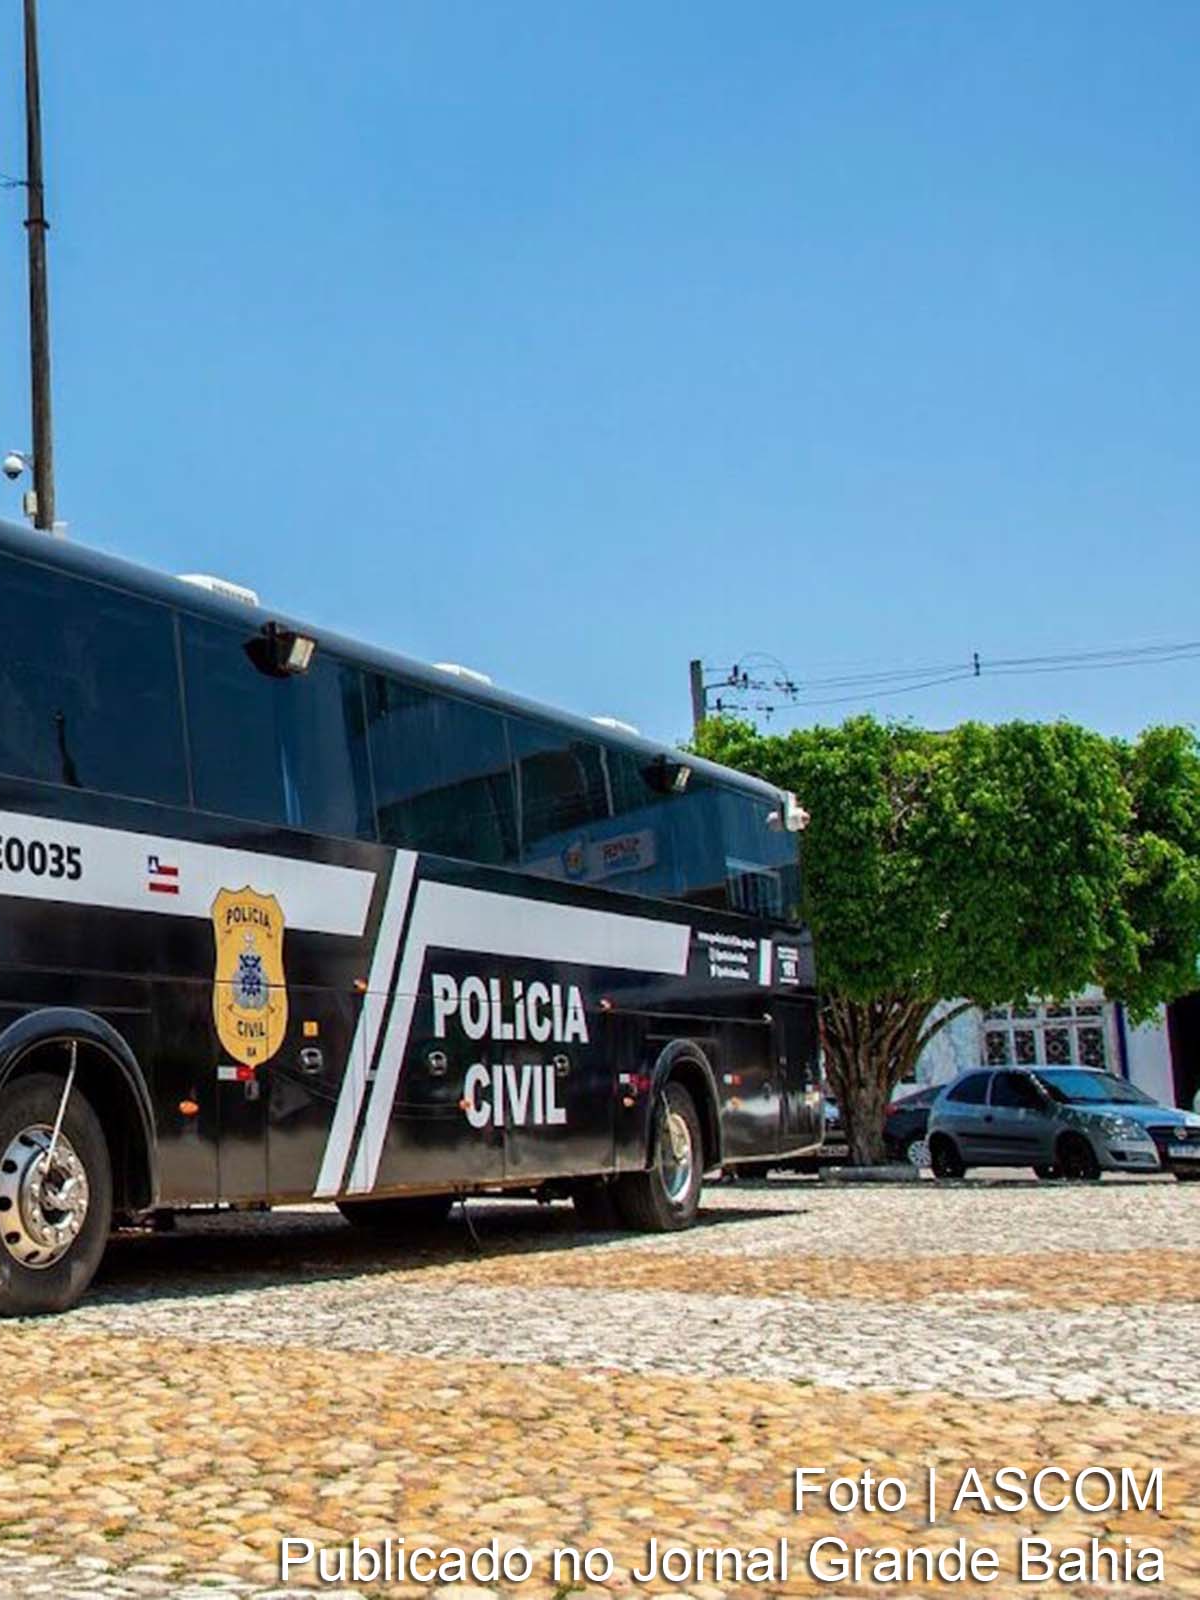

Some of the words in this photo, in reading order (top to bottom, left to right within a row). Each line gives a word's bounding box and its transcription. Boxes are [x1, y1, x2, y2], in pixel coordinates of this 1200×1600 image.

[236, 1019, 268, 1038] CIVIL
[432, 973, 589, 1043] POLÍCIA
[463, 1063, 567, 1128] CIVIL
